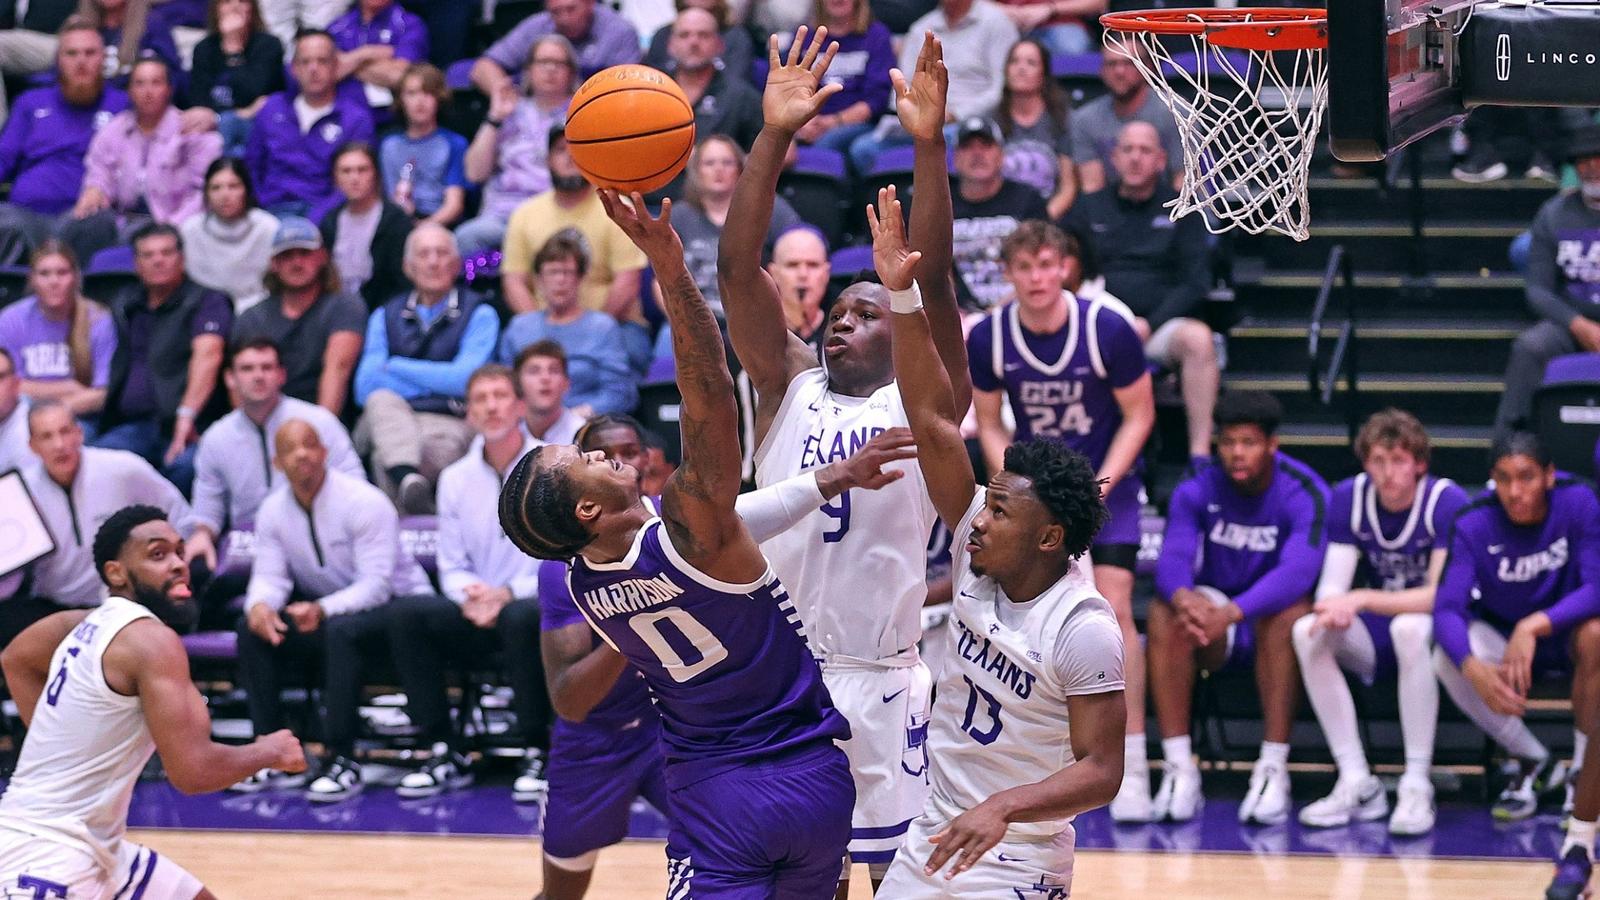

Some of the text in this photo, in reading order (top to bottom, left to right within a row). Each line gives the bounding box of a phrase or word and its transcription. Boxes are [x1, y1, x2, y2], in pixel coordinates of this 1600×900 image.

[1526, 53, 1596, 64] LINCO
[1020, 381, 1084, 404] GCU
[1023, 402, 1093, 437] 24
[819, 488, 851, 543] 9
[584, 572, 685, 620] HARRISON
[628, 606, 729, 683] 0
[957, 619, 1036, 700] TEXANS
[961, 674, 1003, 746] 13
